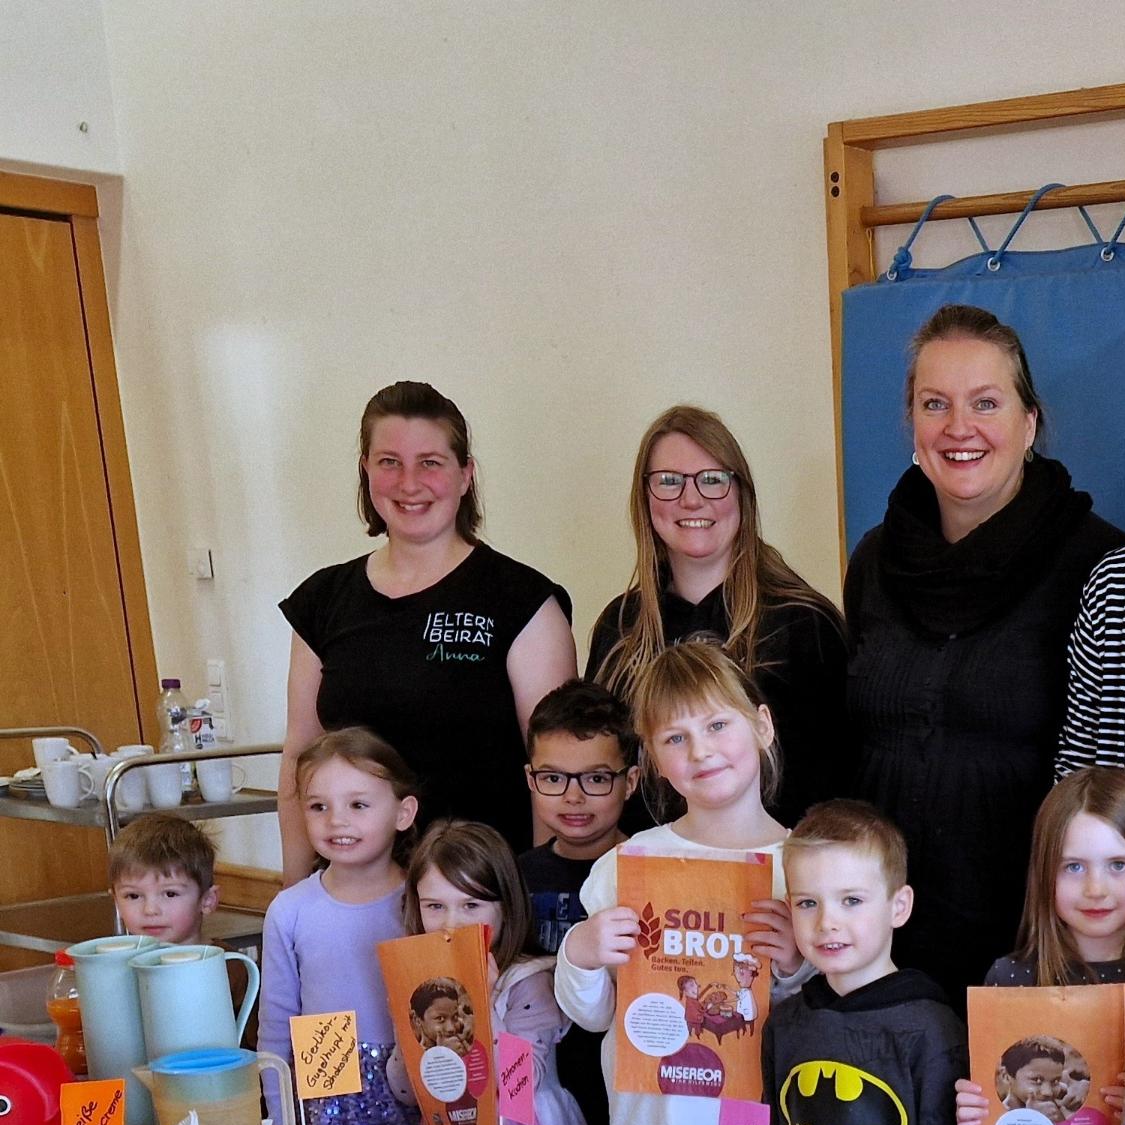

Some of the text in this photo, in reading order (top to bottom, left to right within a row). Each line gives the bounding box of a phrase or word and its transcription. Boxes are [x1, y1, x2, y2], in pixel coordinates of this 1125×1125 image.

[433, 612, 494, 631] ELTERN
[429, 628, 494, 647] BEIRAT
[426, 643, 485, 662] Anna
[663, 908, 725, 932] SOLI
[663, 929, 744, 959] BROT
[660, 1065, 722, 1082] MISEREOR
